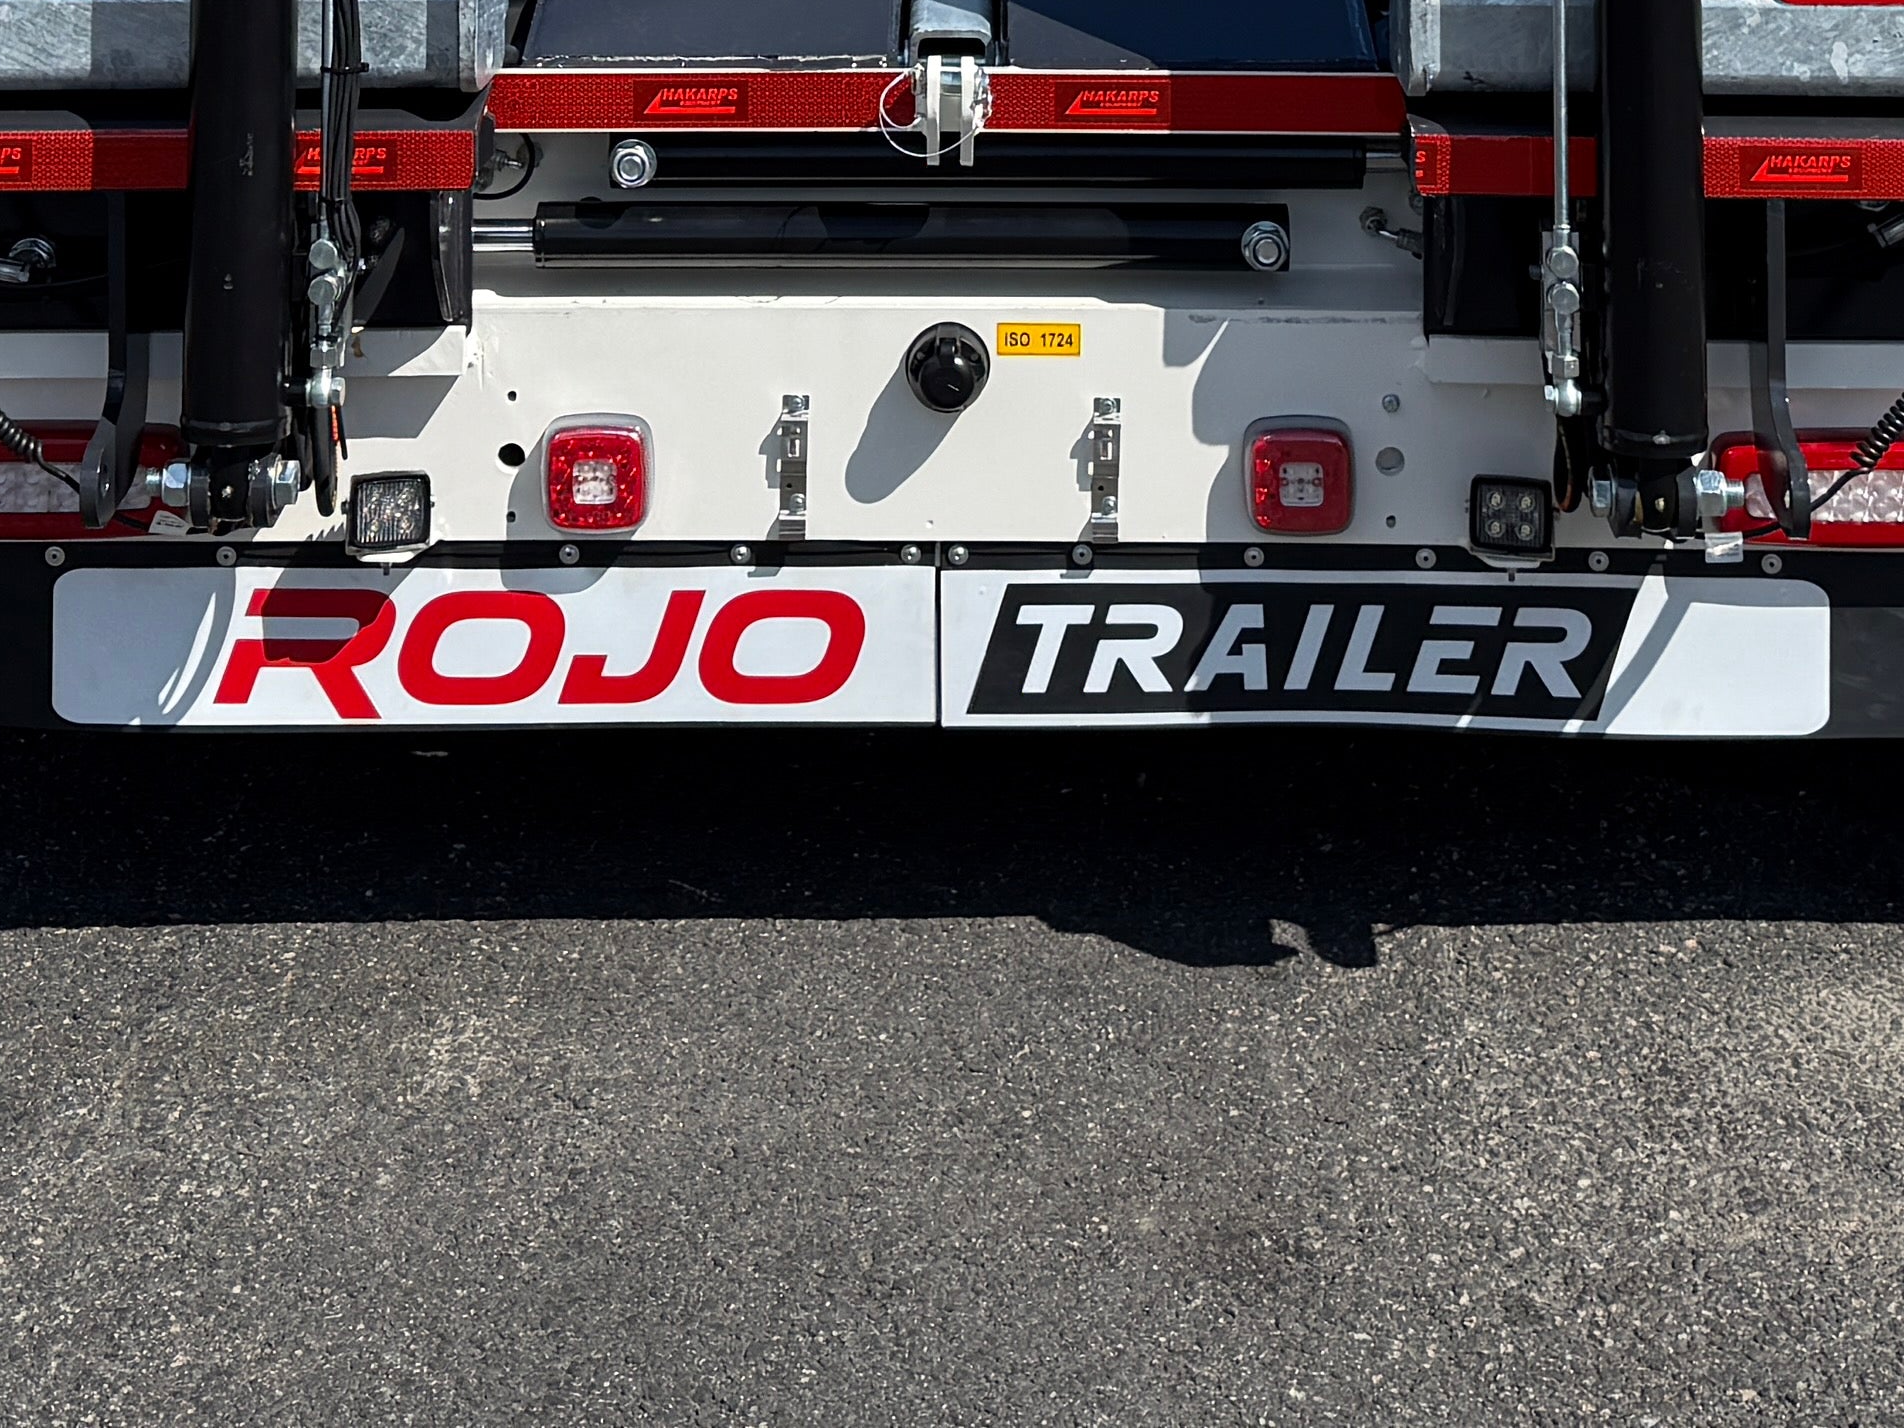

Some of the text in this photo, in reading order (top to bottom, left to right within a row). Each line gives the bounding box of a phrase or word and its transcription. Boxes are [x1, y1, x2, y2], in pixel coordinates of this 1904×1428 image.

[662, 88, 738, 100] HAKARPS
[1083, 90, 1160, 102] HAKARPS
[307, 147, 387, 160] HRPS
[1770, 155, 1851, 168] HAKARPS
[1004, 332, 1073, 347] ISO 1724
[213, 588, 866, 719] ROJO
[1015, 603, 1594, 699] TRAILER
